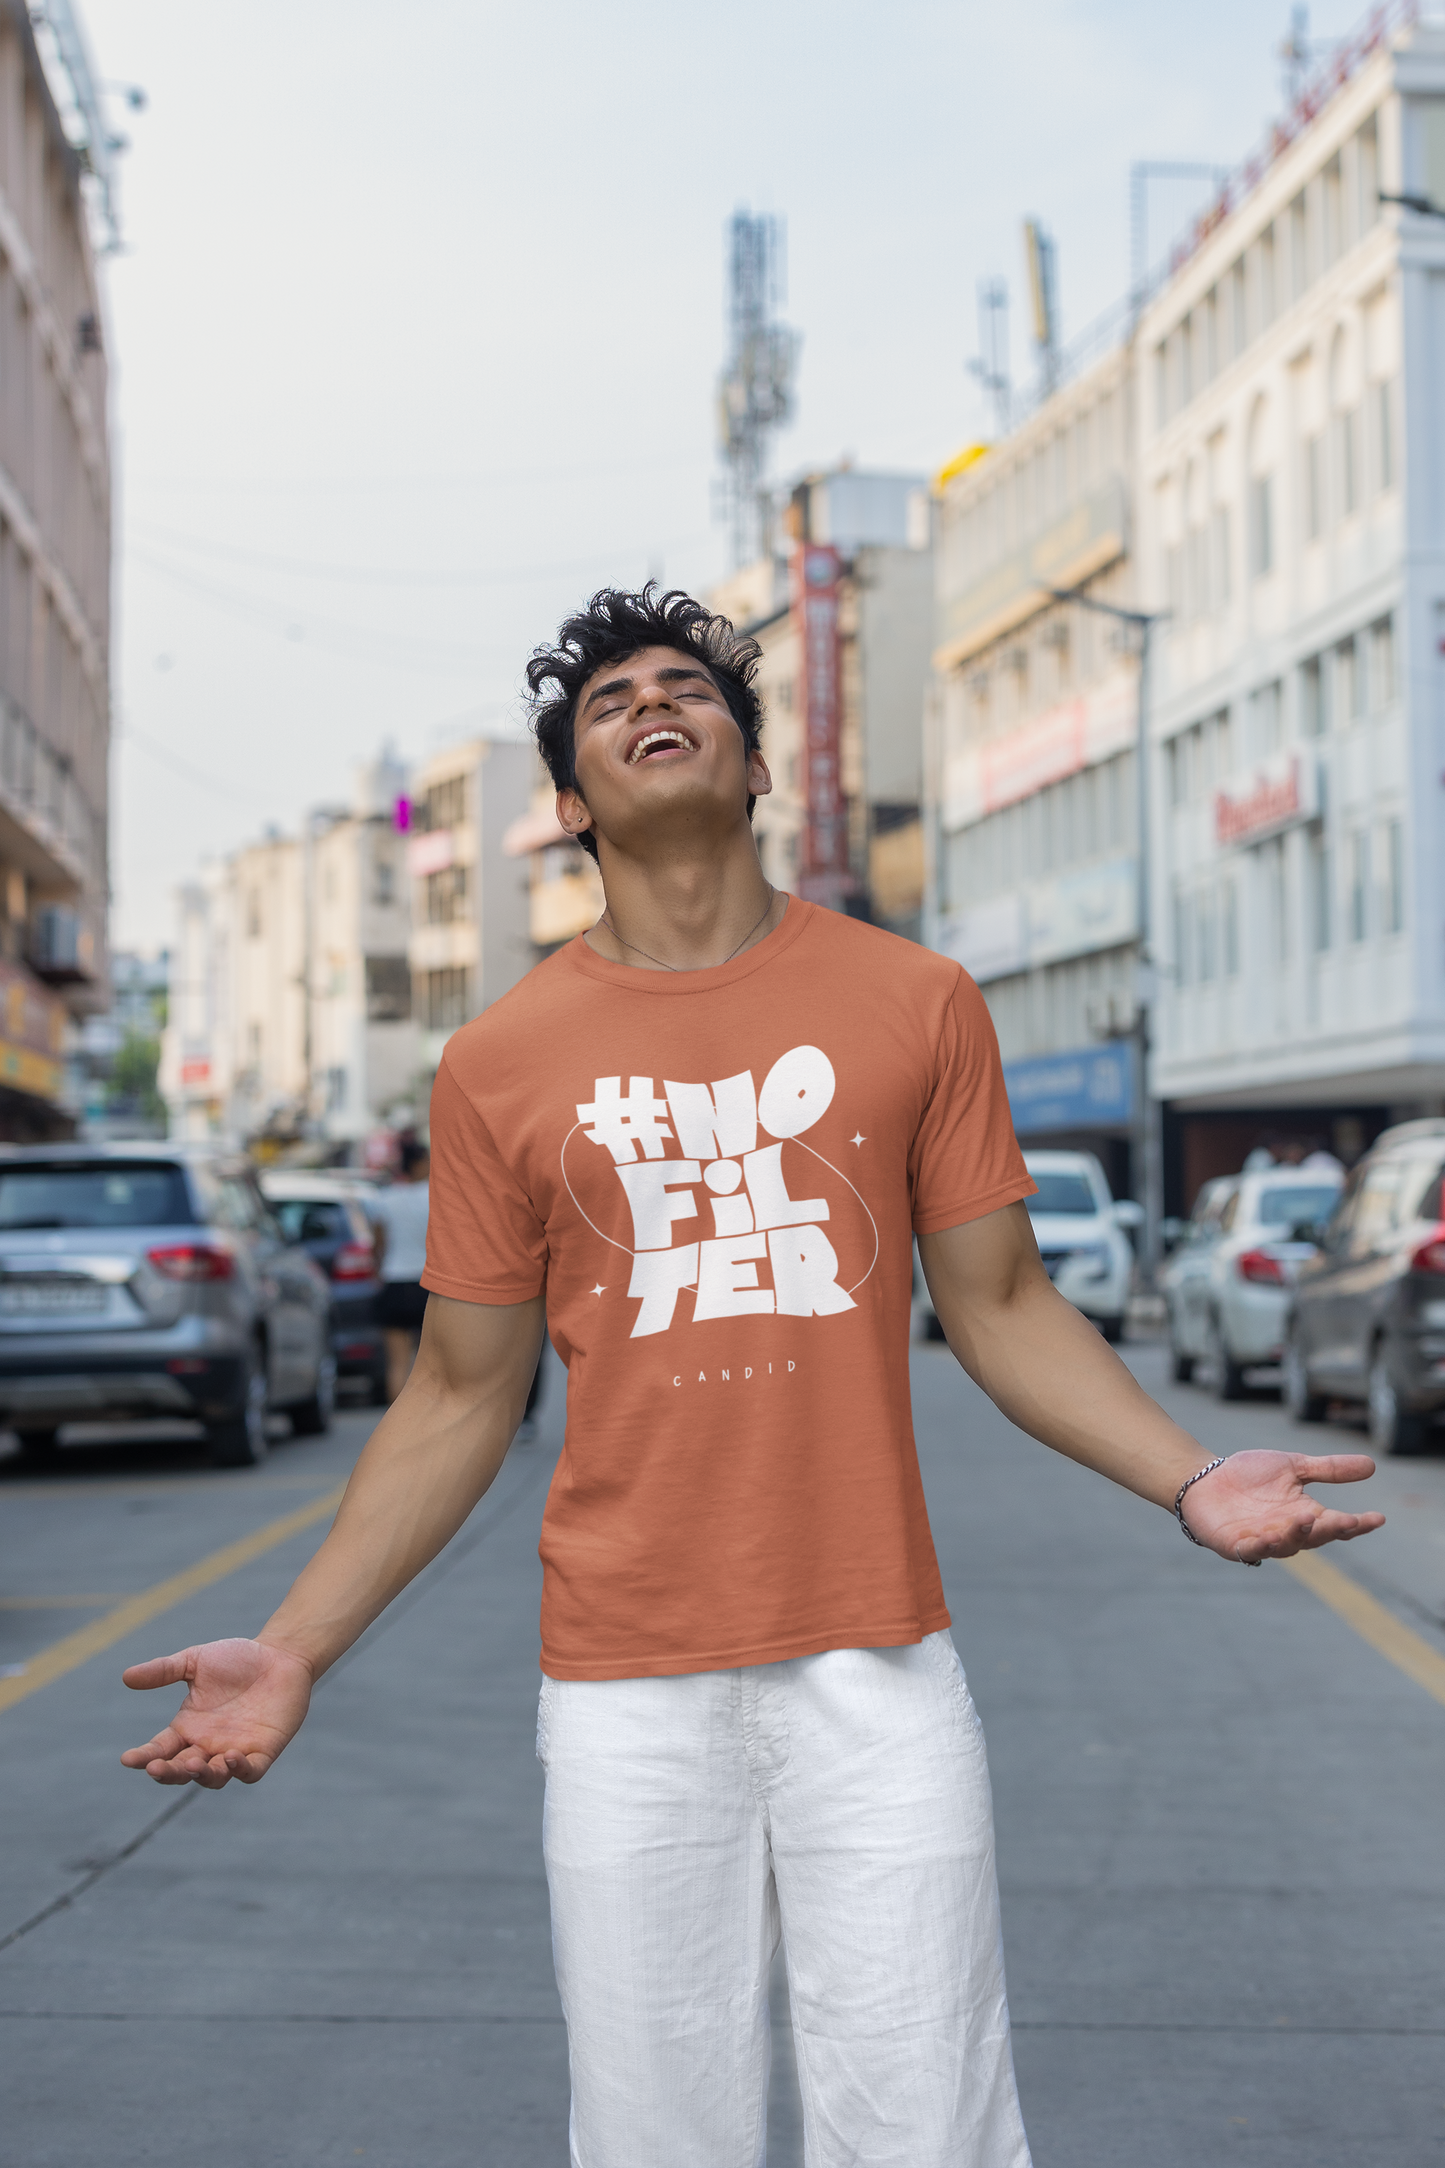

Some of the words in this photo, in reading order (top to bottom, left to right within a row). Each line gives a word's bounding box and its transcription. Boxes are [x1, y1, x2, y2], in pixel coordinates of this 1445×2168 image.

[576, 1045, 836, 1165] #NO
[627, 1224, 859, 1339] TER
[673, 1360, 796, 1387] CANDID
